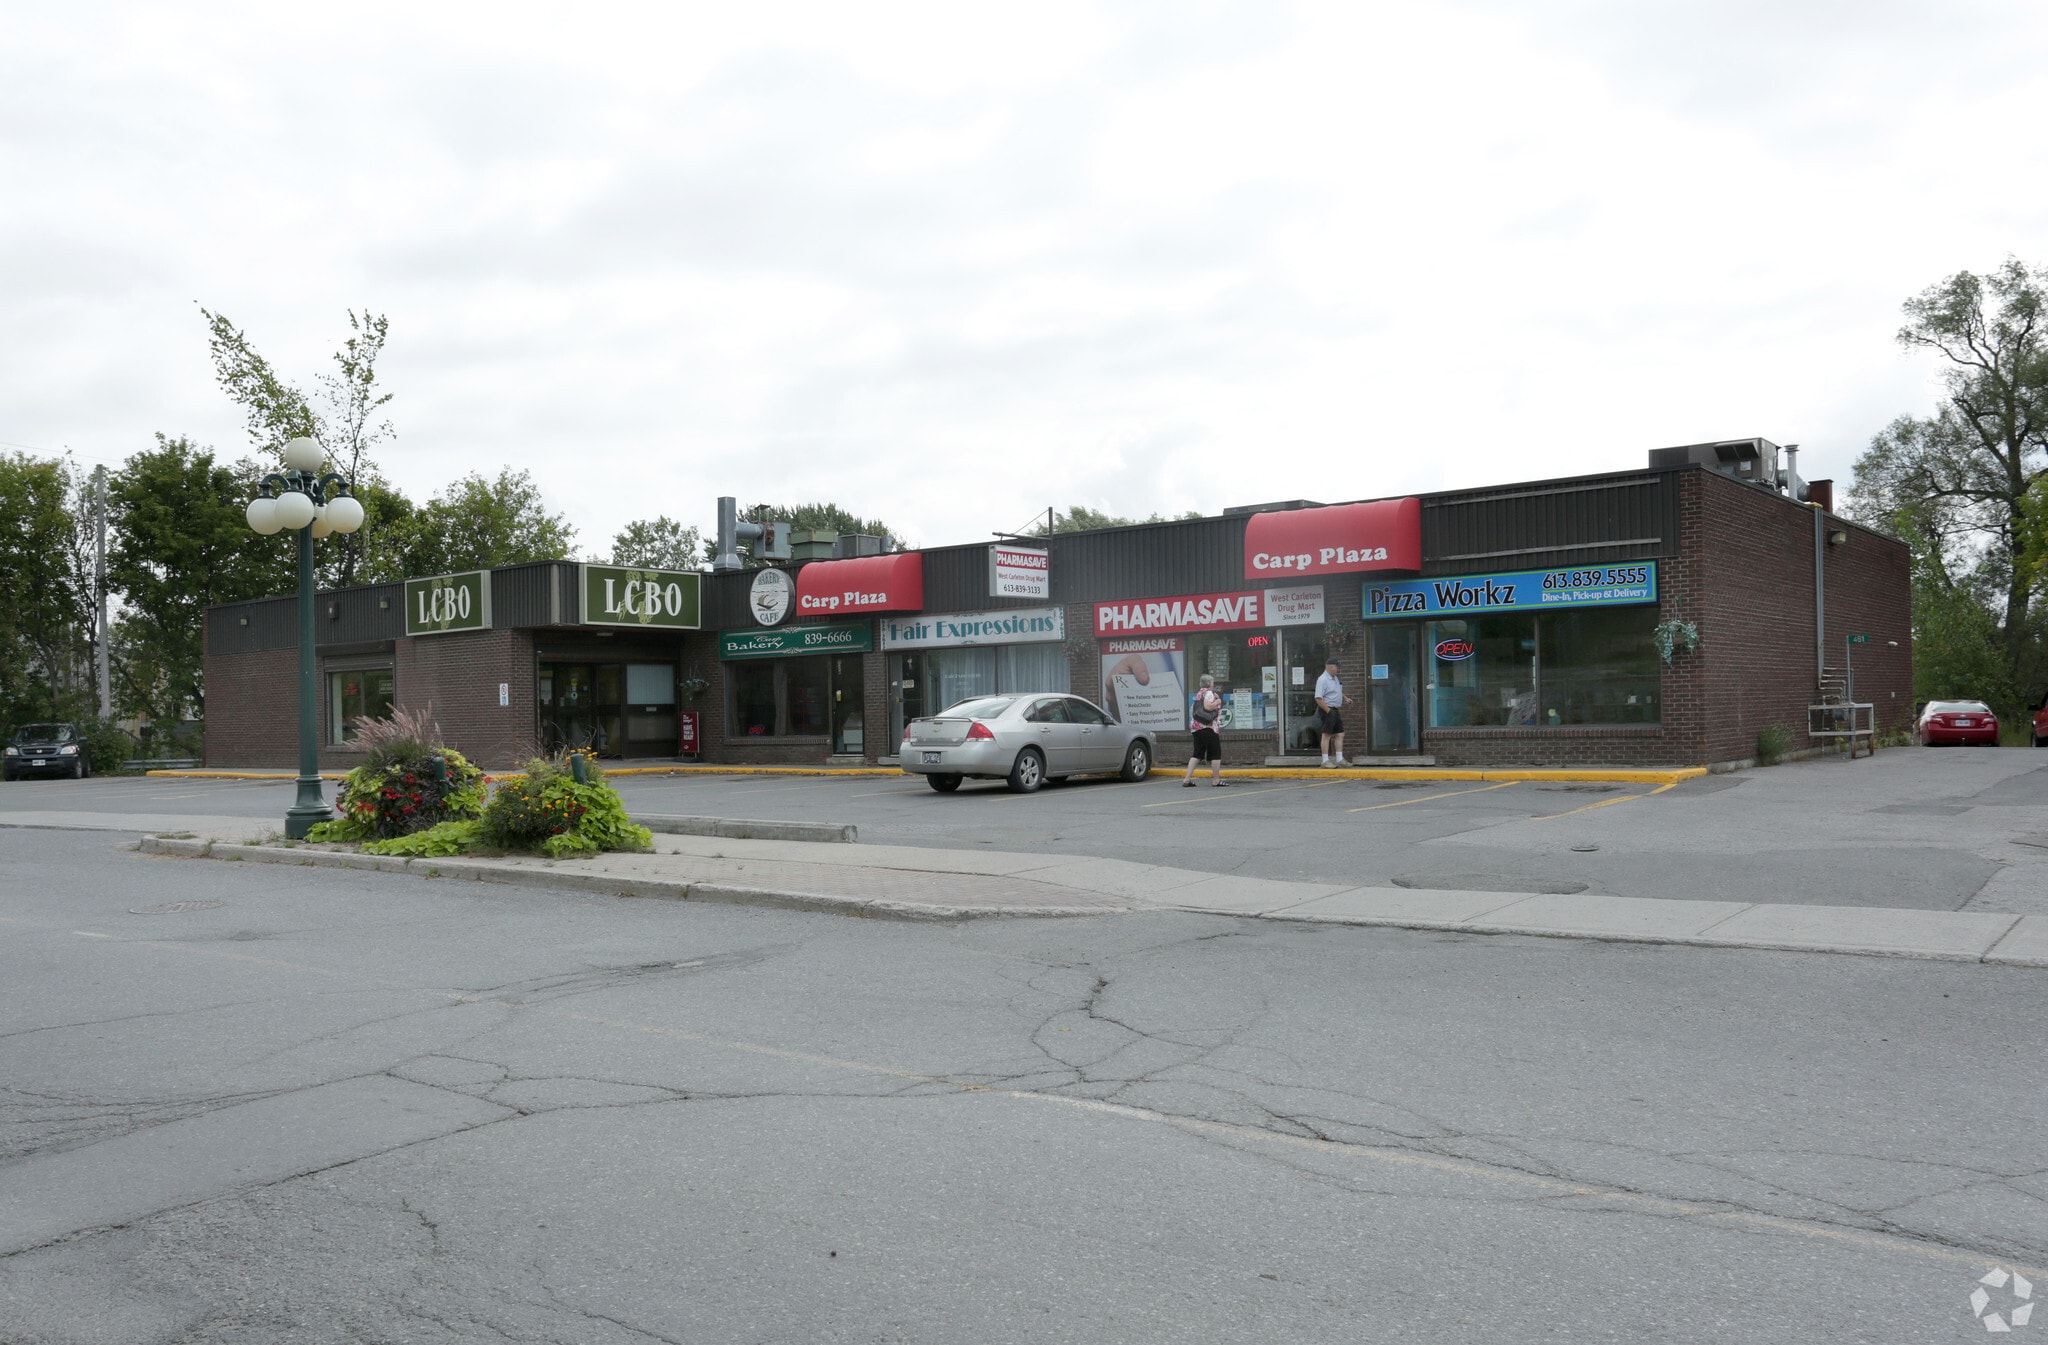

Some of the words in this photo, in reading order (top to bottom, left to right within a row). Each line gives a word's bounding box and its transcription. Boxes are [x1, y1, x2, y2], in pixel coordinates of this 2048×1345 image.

[997, 553, 1047, 568] PHARMASAVE
[1252, 552, 1312, 571] Carp
[1319, 547, 1388, 566] Plaza
[757, 571, 780, 586] BAKERY
[1025, 575, 1036, 583] Drug
[1542, 567, 1647, 589] 613.839.5555
[1003, 584, 1041, 595] 613-839-3133
[1271, 594, 1289, 602] West
[1291, 592, 1322, 601] Carleton
[1369, 586, 1427, 615] Pizza
[1434, 579, 1516, 609] Workz
[1542, 593, 1572, 602] Dine-In,
[1573, 591, 1602, 600] Pick-up
[1603, 590, 1612, 598] &
[1614, 588, 1648, 598] Delivery
[418, 584, 471, 624] LCBO
[604, 578, 682, 617] LCBO
[801, 595, 840, 610] Carp
[843, 591, 887, 606] Plaza
[1099, 596, 1258, 631] PHARMASAVE
[1278, 604, 1295, 613] Drug
[1298, 602, 1316, 610] Mart
[890, 622, 930, 641] Hair
[936, 615, 1054, 638] Expressions
[804, 630, 852, 645] 839-6666
[1109, 638, 1176, 652] PHARMASAVE
[1248, 636, 1269, 647] OPEN
[727, 641, 784, 651] Bakery
[1436, 643, 1473, 655] OPEN
